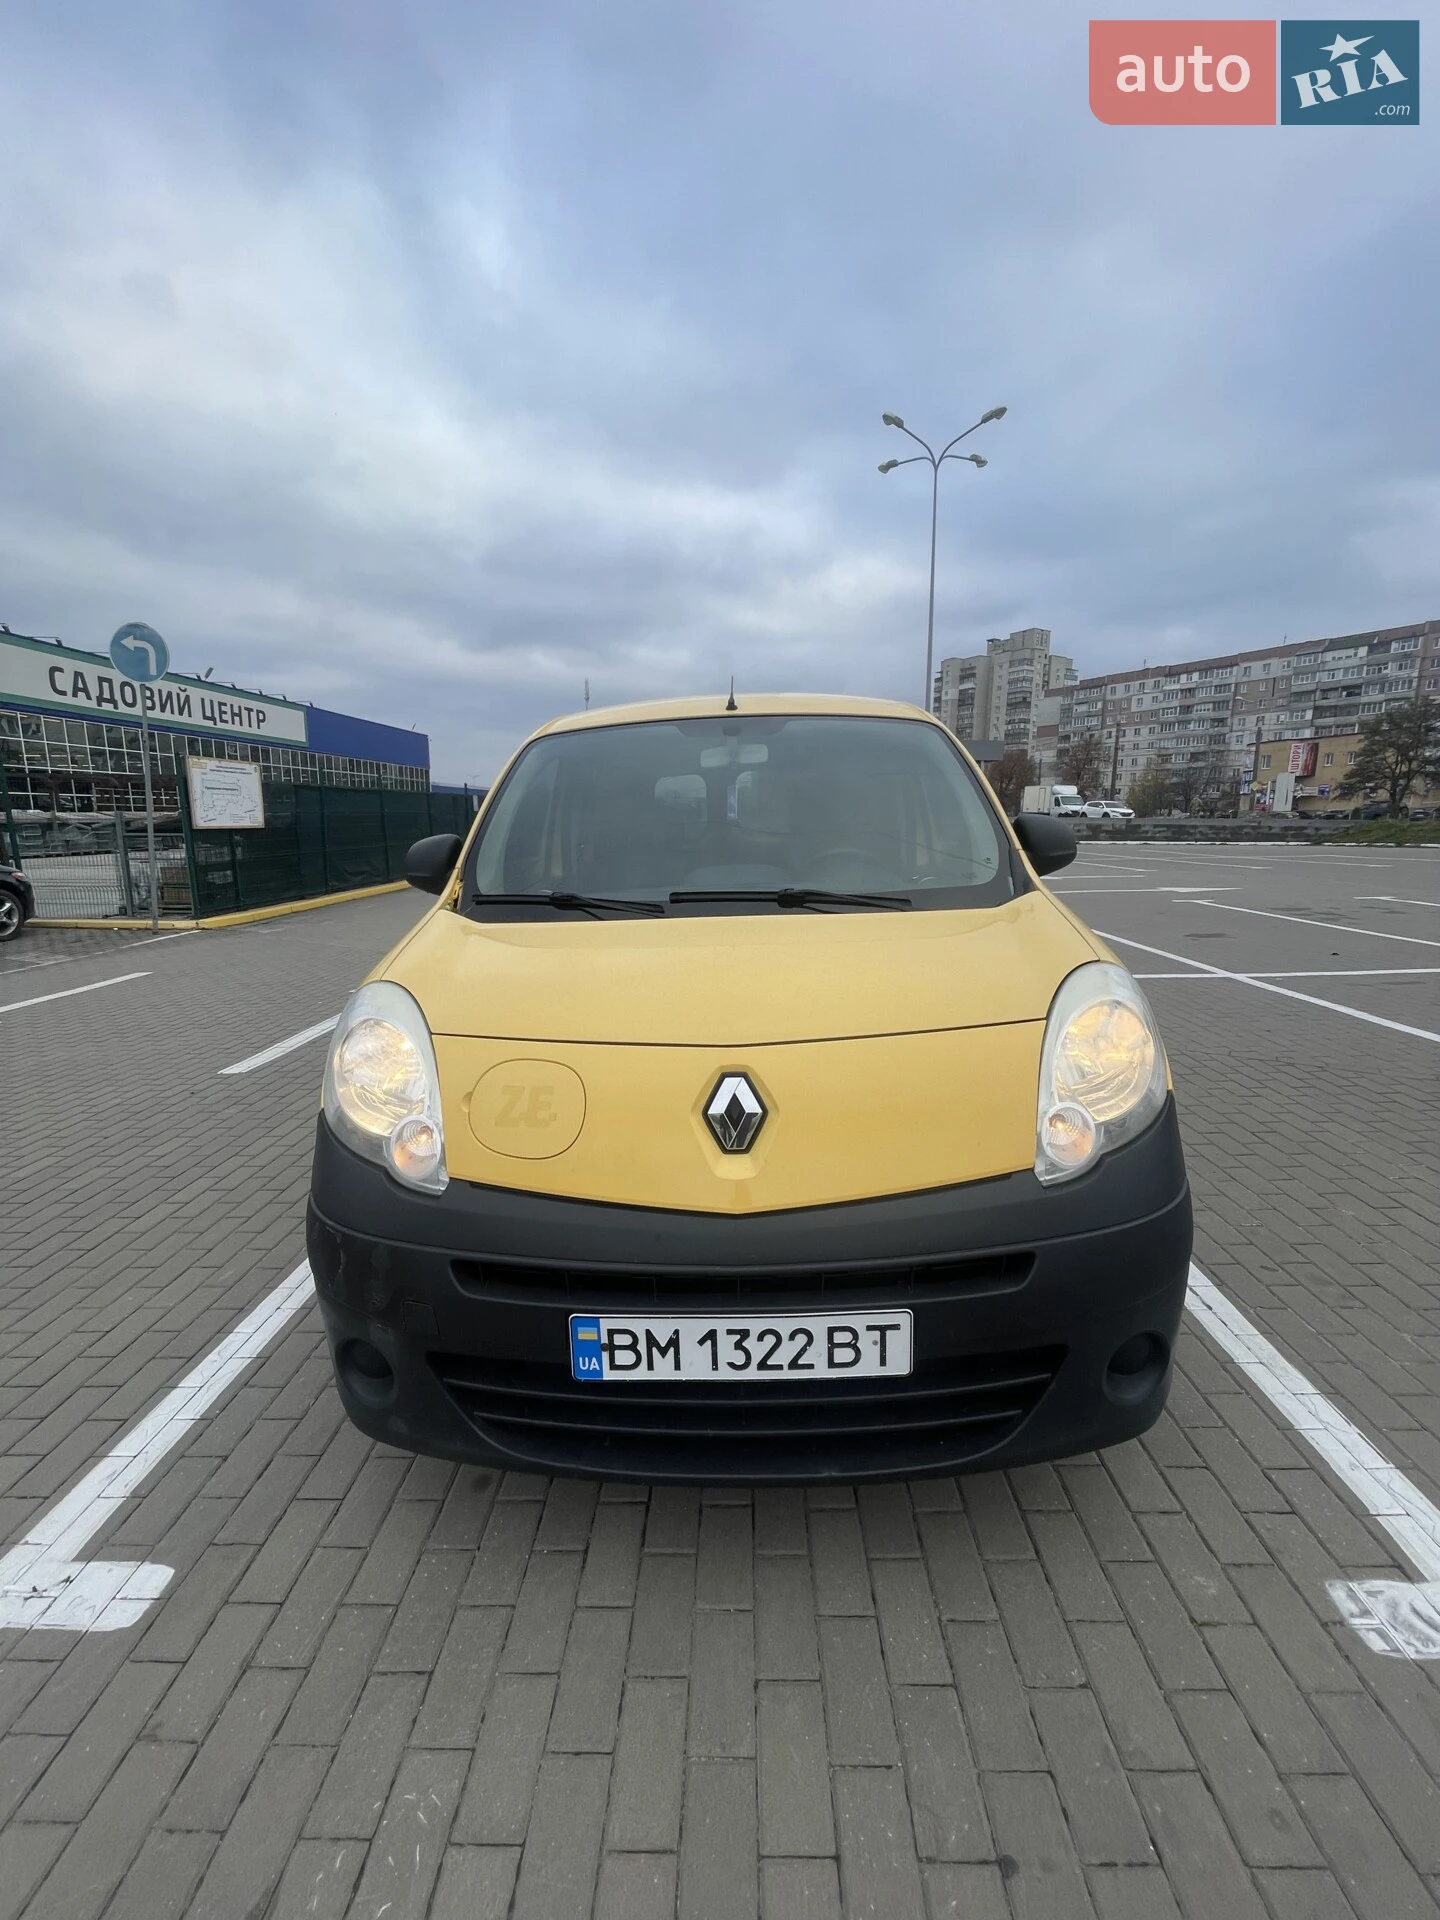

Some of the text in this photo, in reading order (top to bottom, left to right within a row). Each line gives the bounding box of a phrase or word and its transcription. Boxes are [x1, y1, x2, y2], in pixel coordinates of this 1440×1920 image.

[48, 666, 267, 730] САДОВИЙ ЦЕНТР
[1290, 744, 1302, 771] ШТОРИ
[579, 1357, 600, 1371] UA
[606, 1324, 901, 1371] BM 1322 BT
